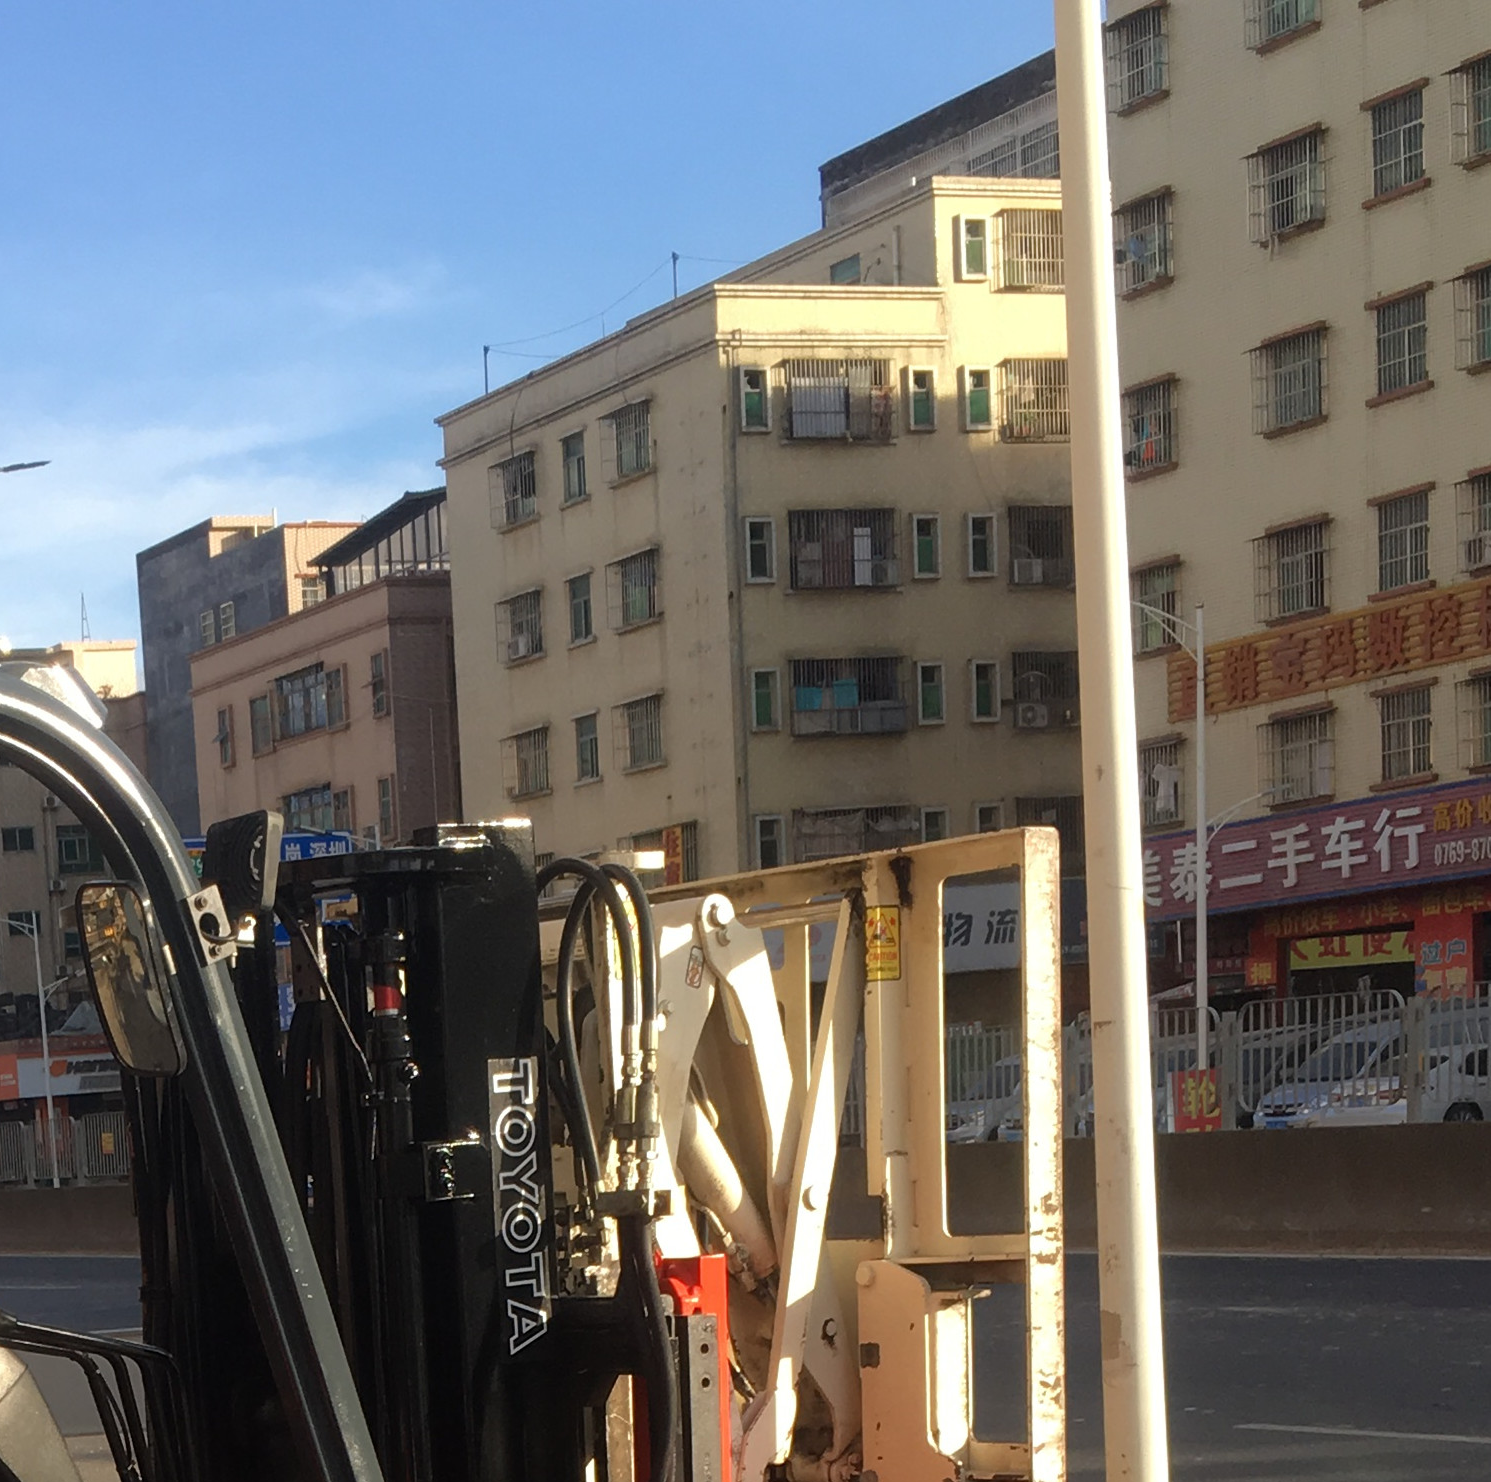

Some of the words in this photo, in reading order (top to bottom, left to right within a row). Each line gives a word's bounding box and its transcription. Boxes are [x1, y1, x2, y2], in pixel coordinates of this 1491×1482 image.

[945, 908, 1019, 947] 物流
[1422, 939, 1467, 966] 过户
[493, 1058, 548, 1356] TOYOTA
